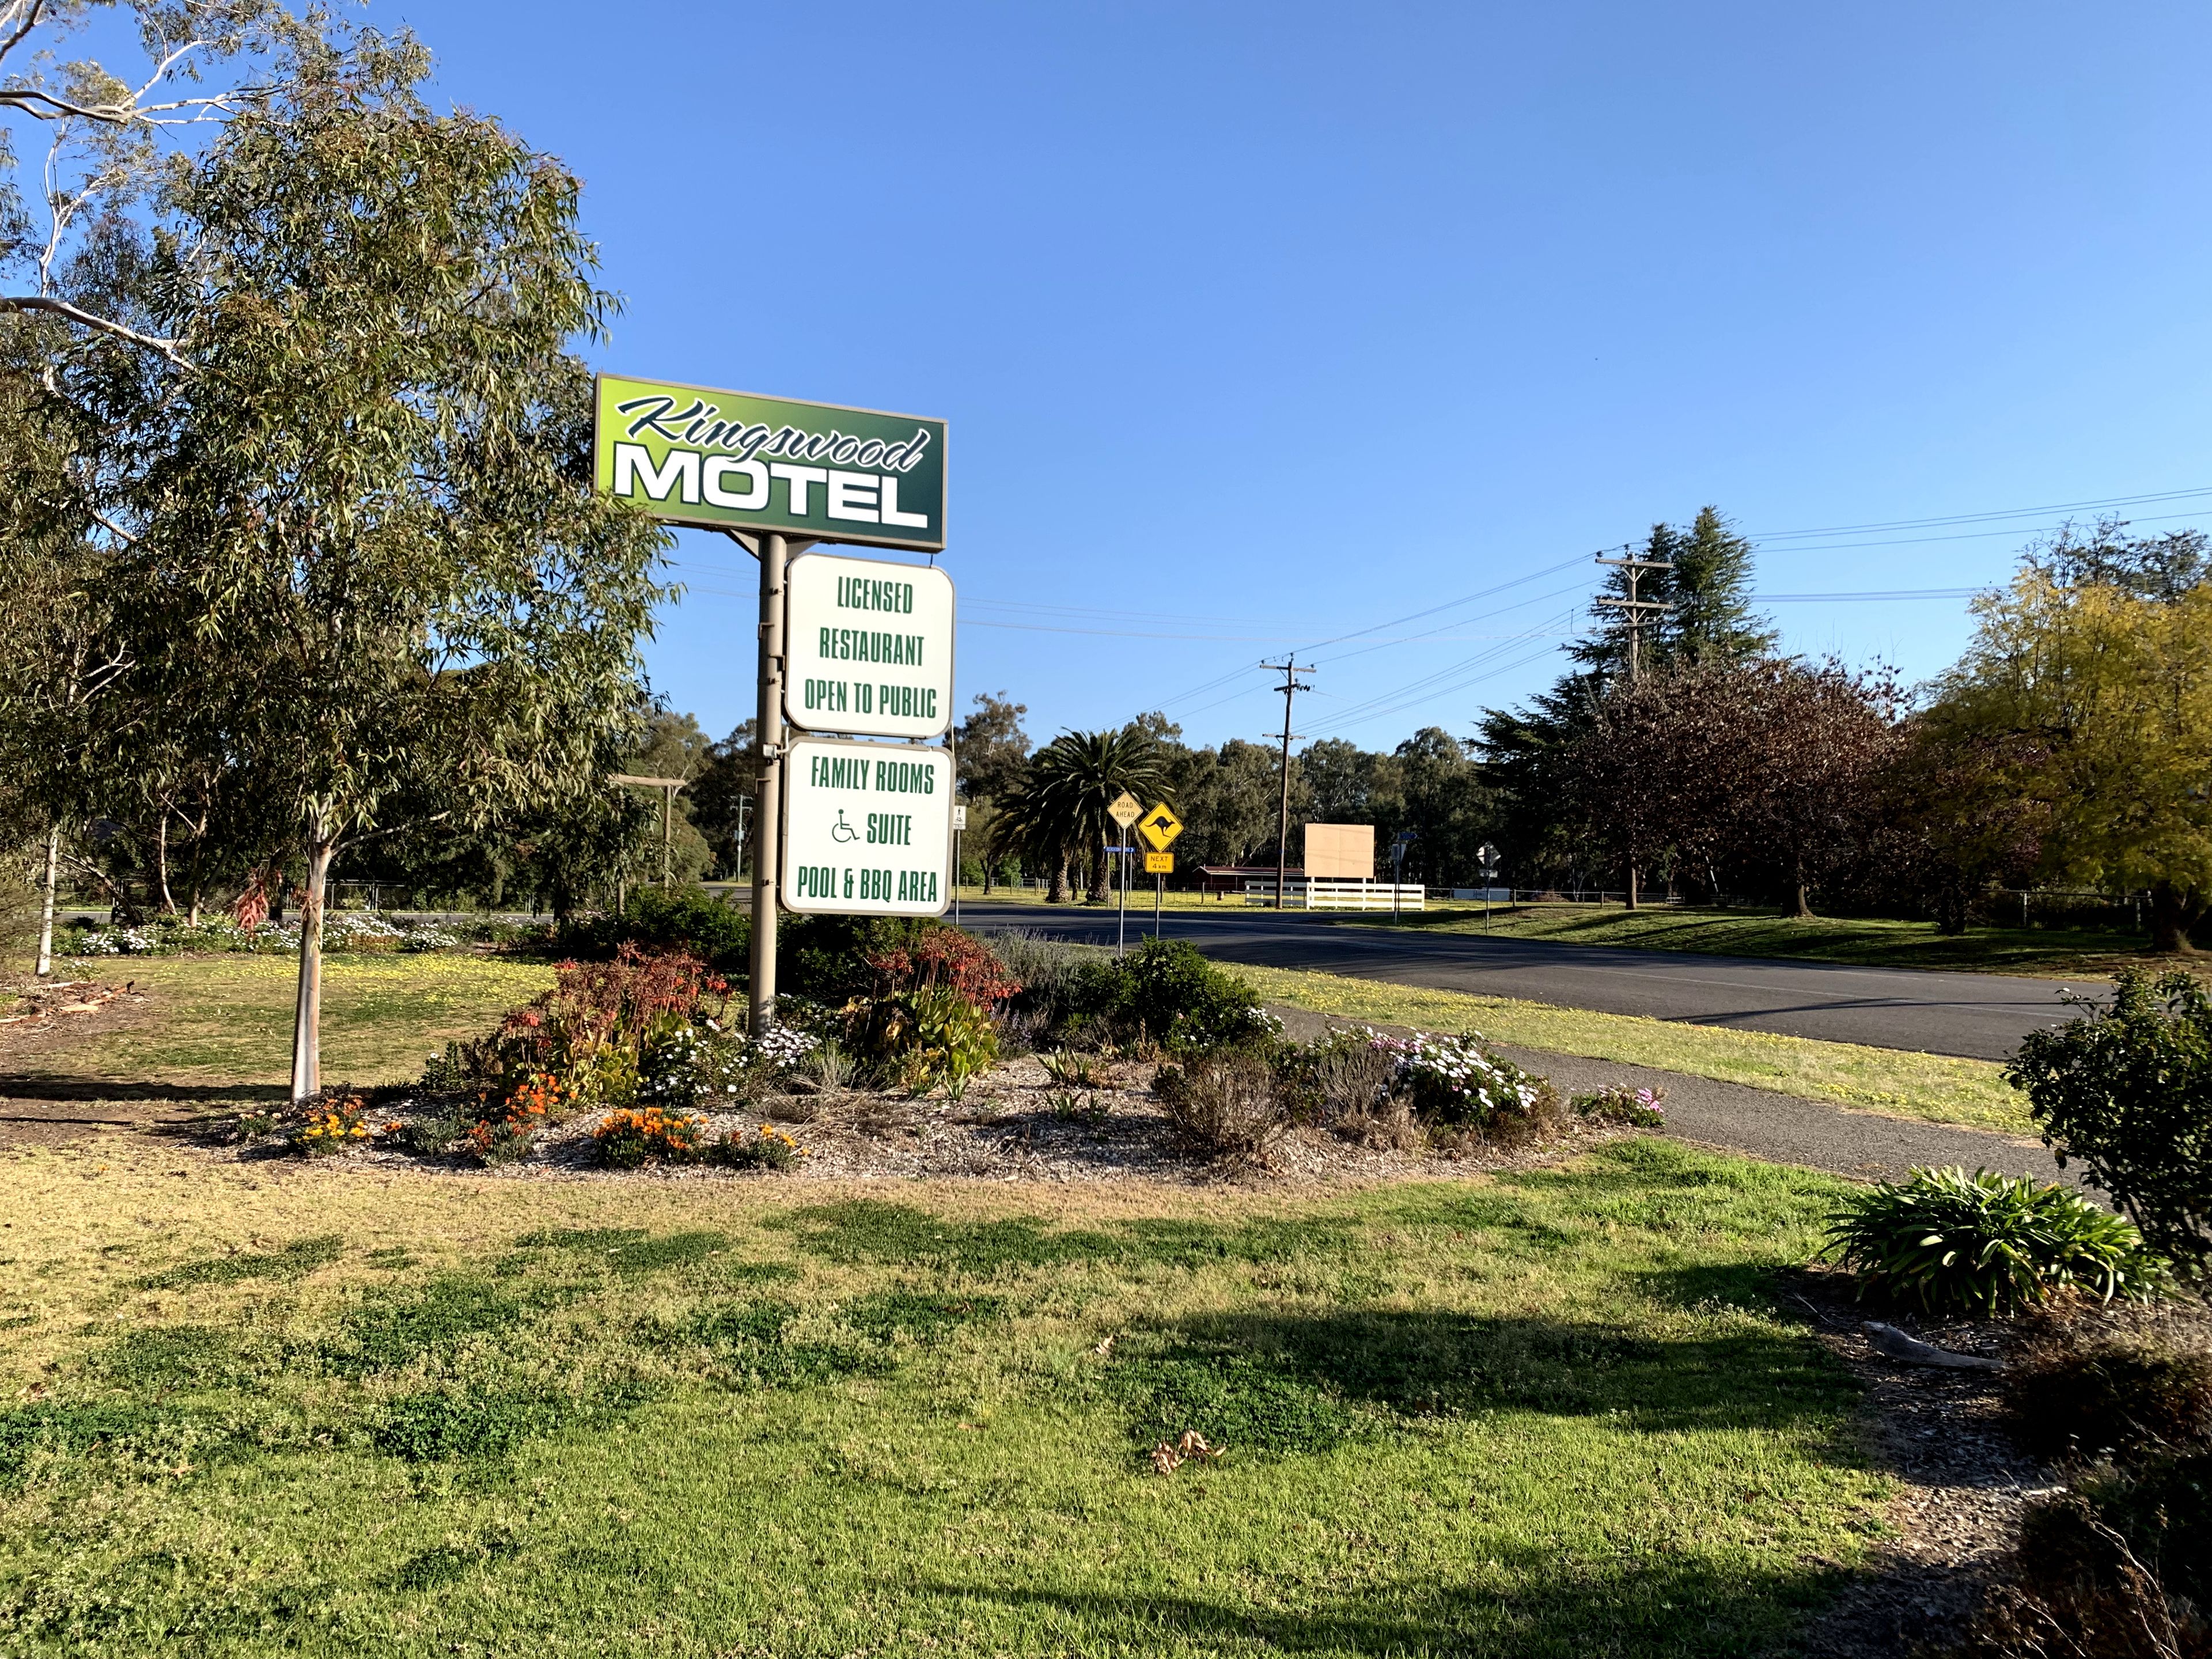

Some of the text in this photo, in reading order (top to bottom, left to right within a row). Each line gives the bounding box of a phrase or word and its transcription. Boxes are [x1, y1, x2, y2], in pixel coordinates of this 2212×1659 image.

[615, 395, 930, 471] Kingswood
[614, 442, 928, 529] MOTEL
[838, 577, 912, 613] LICENSED
[820, 627, 924, 666] RESTAURANT
[805, 679, 936, 718] OPEN TO PUBLIC
[812, 756, 934, 794] FAMILY ROOMS
[867, 813, 911, 845] SUITE
[798, 866, 937, 903] POOL & BBQ AREA
